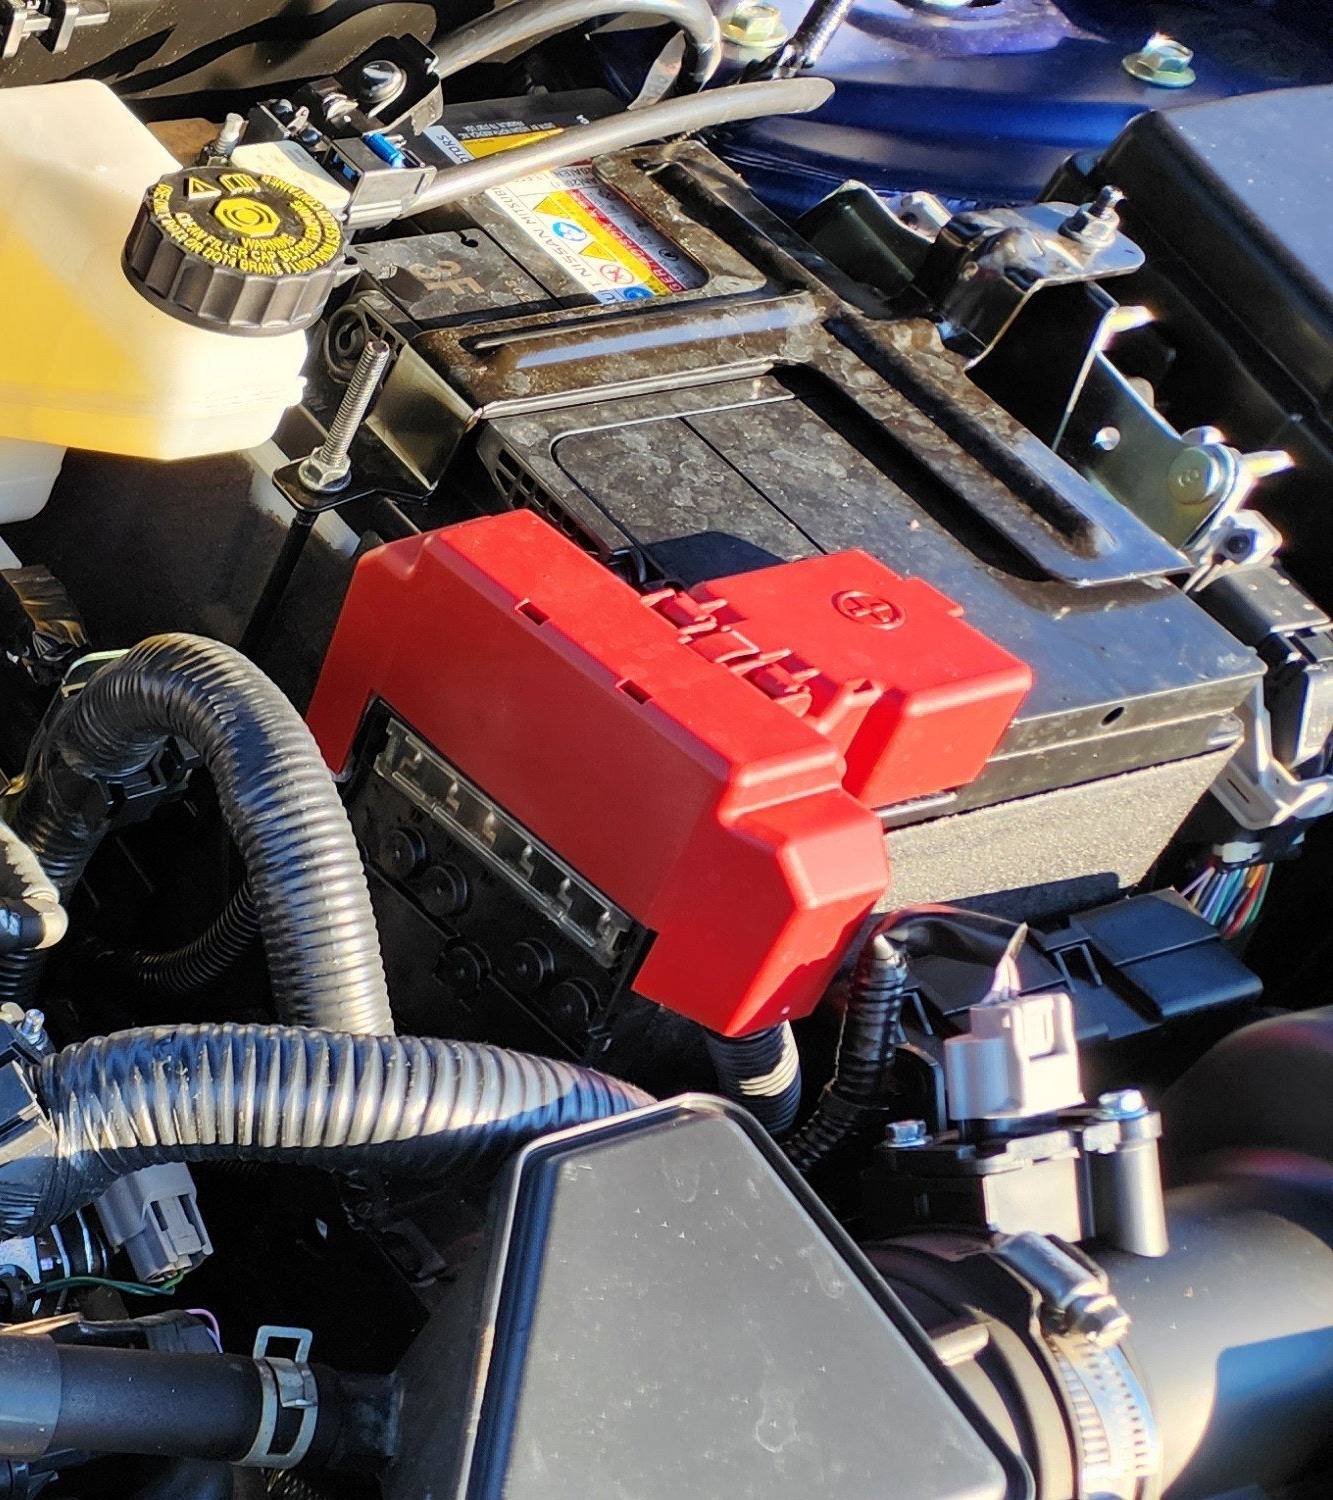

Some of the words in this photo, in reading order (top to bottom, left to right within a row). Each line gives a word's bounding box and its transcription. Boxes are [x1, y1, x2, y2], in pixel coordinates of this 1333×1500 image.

[436, 135, 471, 163] OTORS
[202, 236, 248, 259] FILLER
[250, 250, 277, 263] CAP
[533, 229, 591, 278] NISSAN
[239, 260, 283, 275] BRAKE
